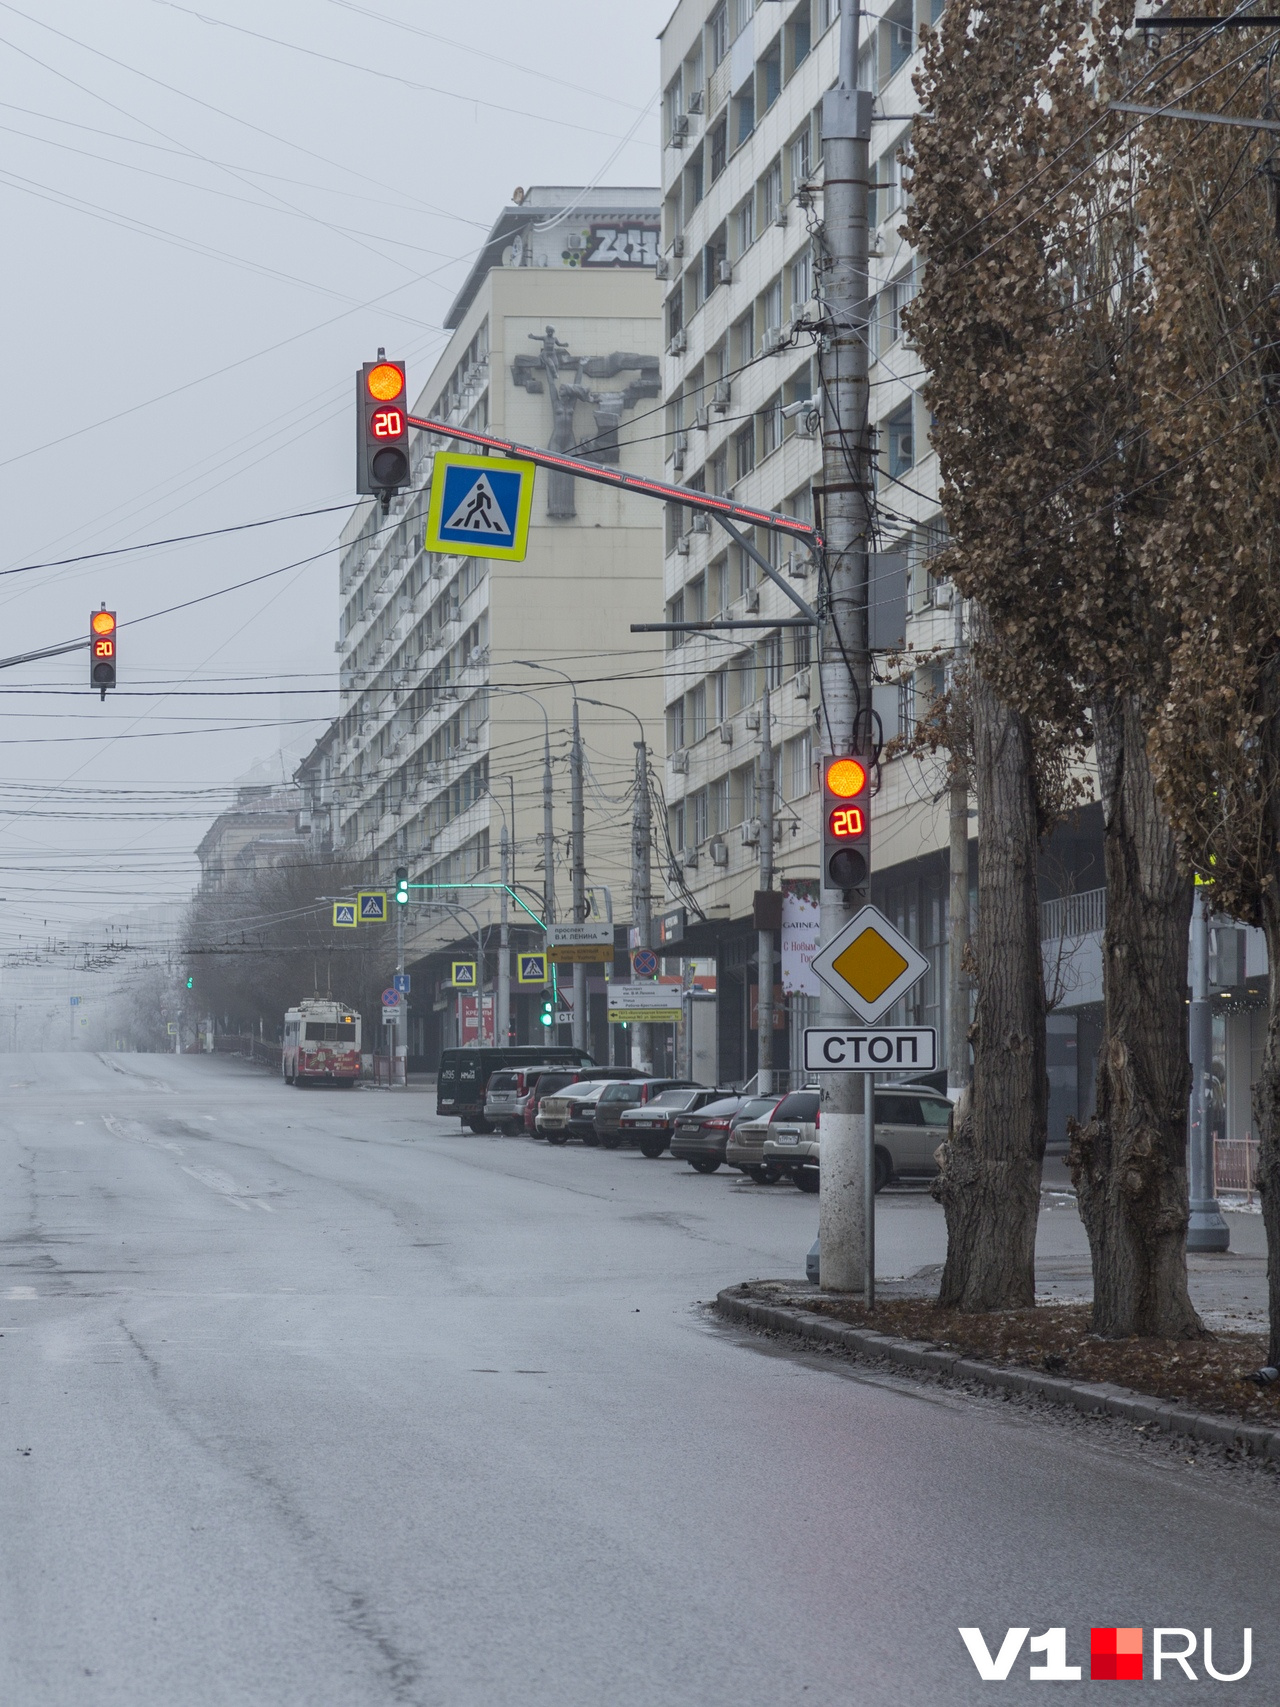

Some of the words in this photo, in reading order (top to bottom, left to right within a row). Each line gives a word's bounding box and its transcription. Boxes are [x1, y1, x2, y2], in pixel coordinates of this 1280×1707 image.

[375, 412, 401, 436] 20
[96, 641, 113, 656] 20
[833, 809, 862, 835] 20
[782, 921, 820, 929] GATINEA
[465, 1009, 492, 1017] КРЕИТЫ
[823, 1036, 917, 1064] СТОП
